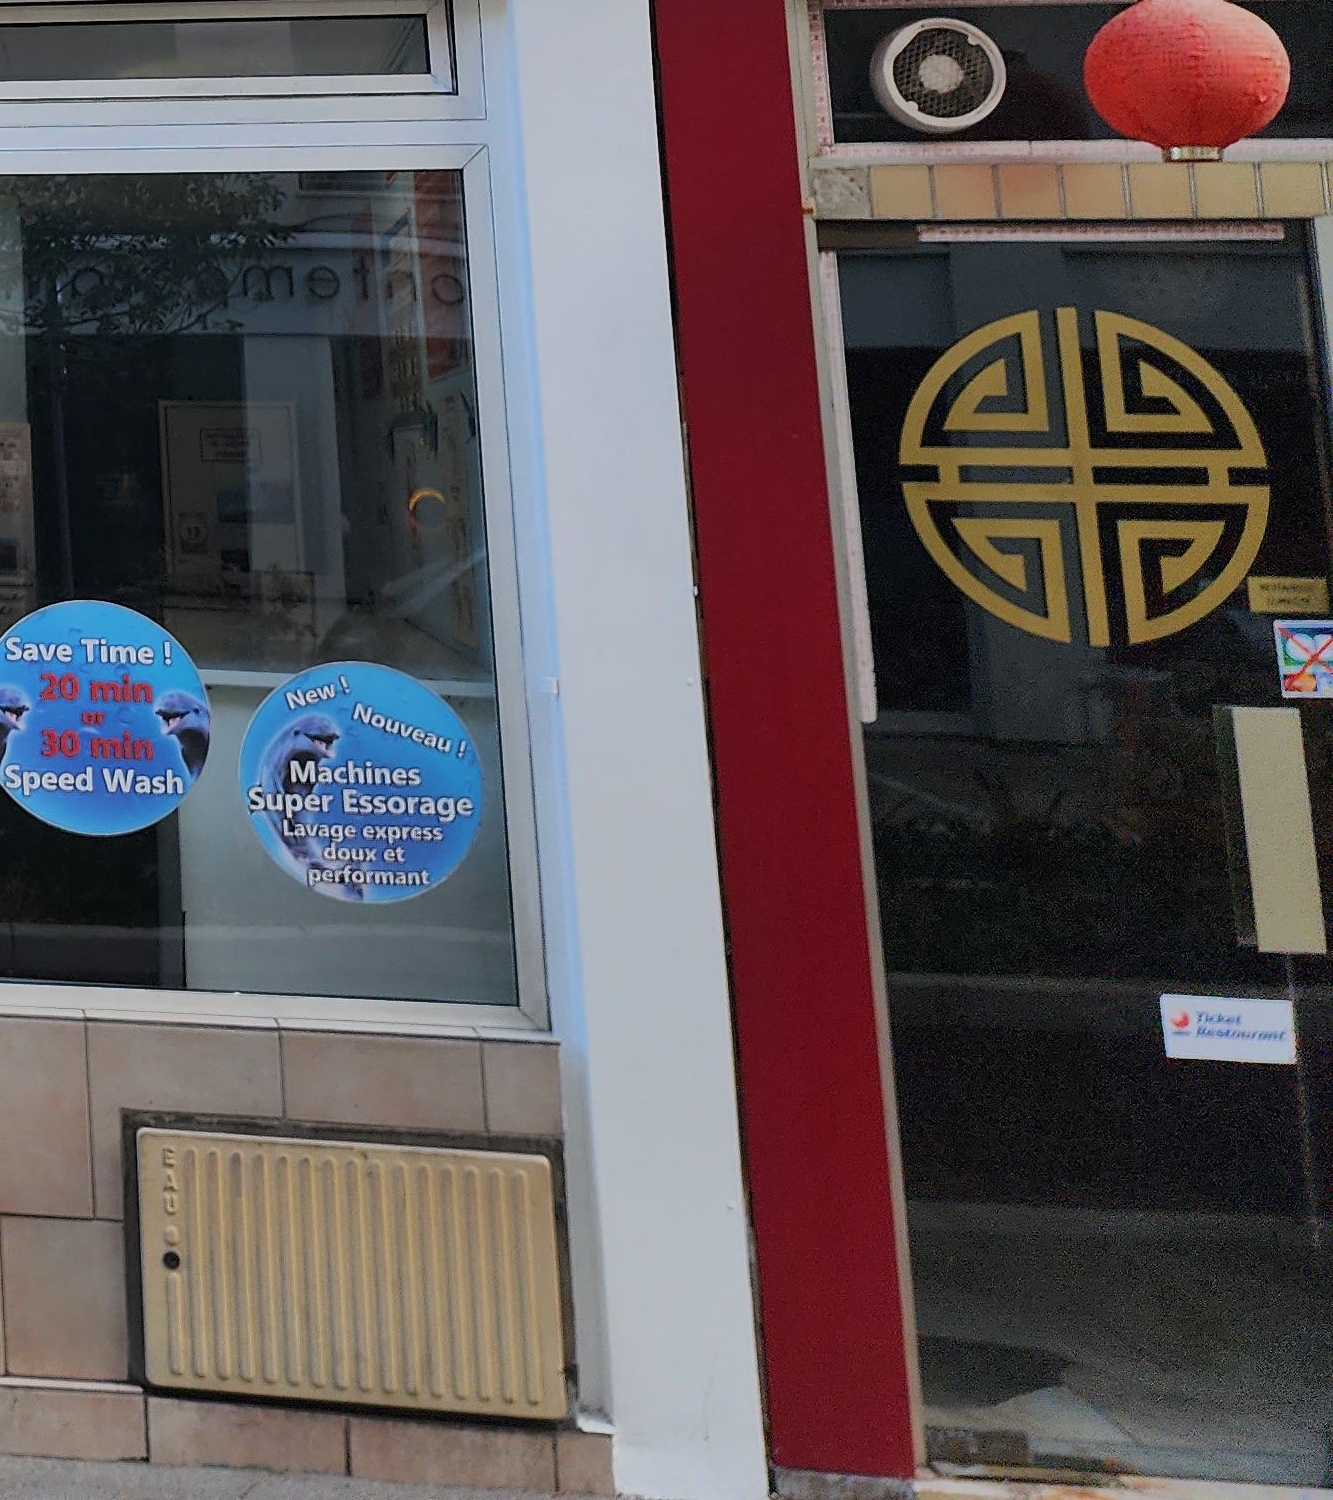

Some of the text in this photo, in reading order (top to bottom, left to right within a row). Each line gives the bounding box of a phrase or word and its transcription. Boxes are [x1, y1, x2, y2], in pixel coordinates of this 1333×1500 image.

[5, 636, 173, 666] Save Time !
[39, 672, 154, 703] 20 min
[285, 675, 351, 711] New !
[81, 711, 106, 726] or
[352, 702, 467, 759] Nouveau !
[41, 729, 155, 760] 30 min
[4, 764, 184, 796] Speed Wash
[289, 760, 422, 786] Machines
[248, 786, 475, 823] Super Essorage
[283, 818, 444, 844] Lavage express
[322, 842, 406, 864] doux et
[307, 866, 431, 887] performant
[1196, 1010, 1243, 1025] Ticket
[1195, 1026, 1287, 1042] Restaurant
[162, 1144, 178, 1216] EAU
